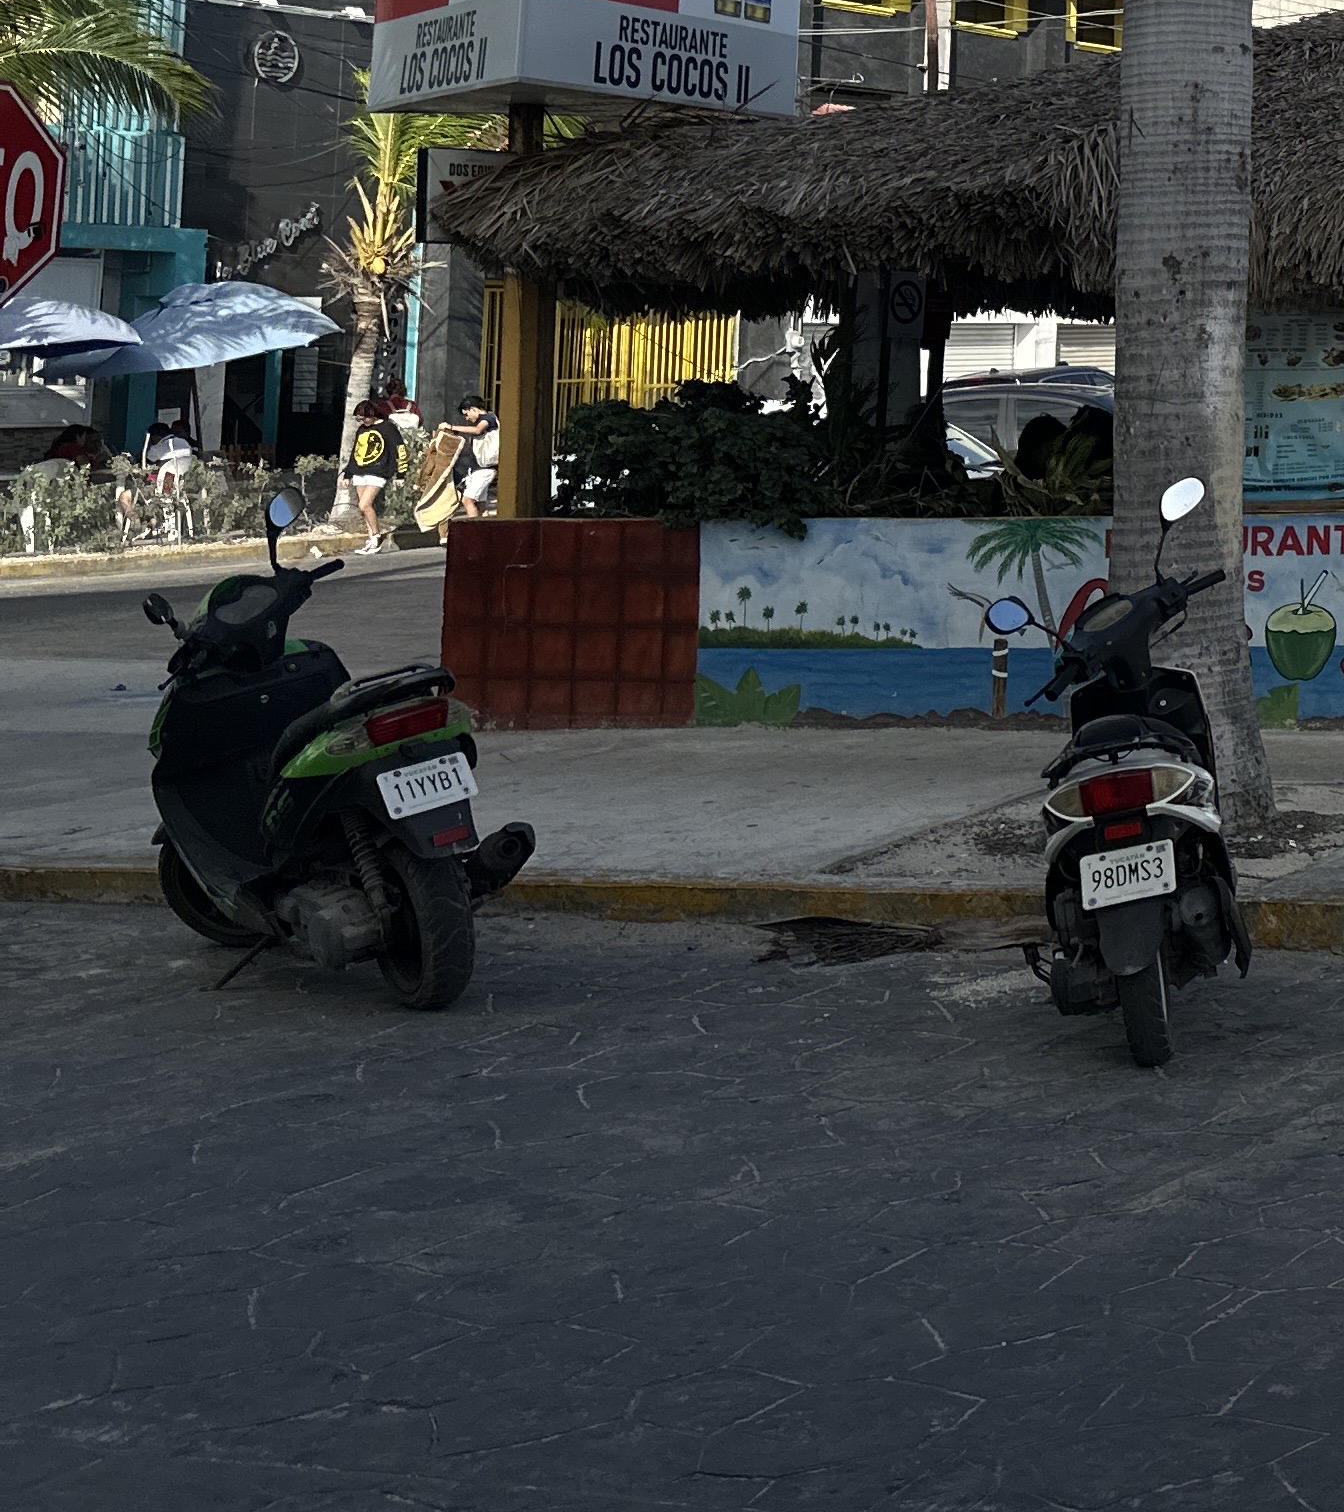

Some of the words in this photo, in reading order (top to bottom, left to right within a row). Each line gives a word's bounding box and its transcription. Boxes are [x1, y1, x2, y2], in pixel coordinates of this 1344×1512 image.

[415, 9, 477, 49] RESTAURANTE
[619, 14, 728, 59] RESTAURANTE
[400, 49, 427, 95] LOS
[428, 39, 475, 90] COCOS
[475, 36, 488, 80] II
[593, 41, 642, 88] LOS
[651, 50, 729, 101] COCOS
[736, 64, 750, 104] II
[449, 162, 469, 177] DOS
[0, 149, 44, 252] O
[393, 767, 463, 803] 11YYB1
[1091, 857, 1165, 893] 98DMS3
